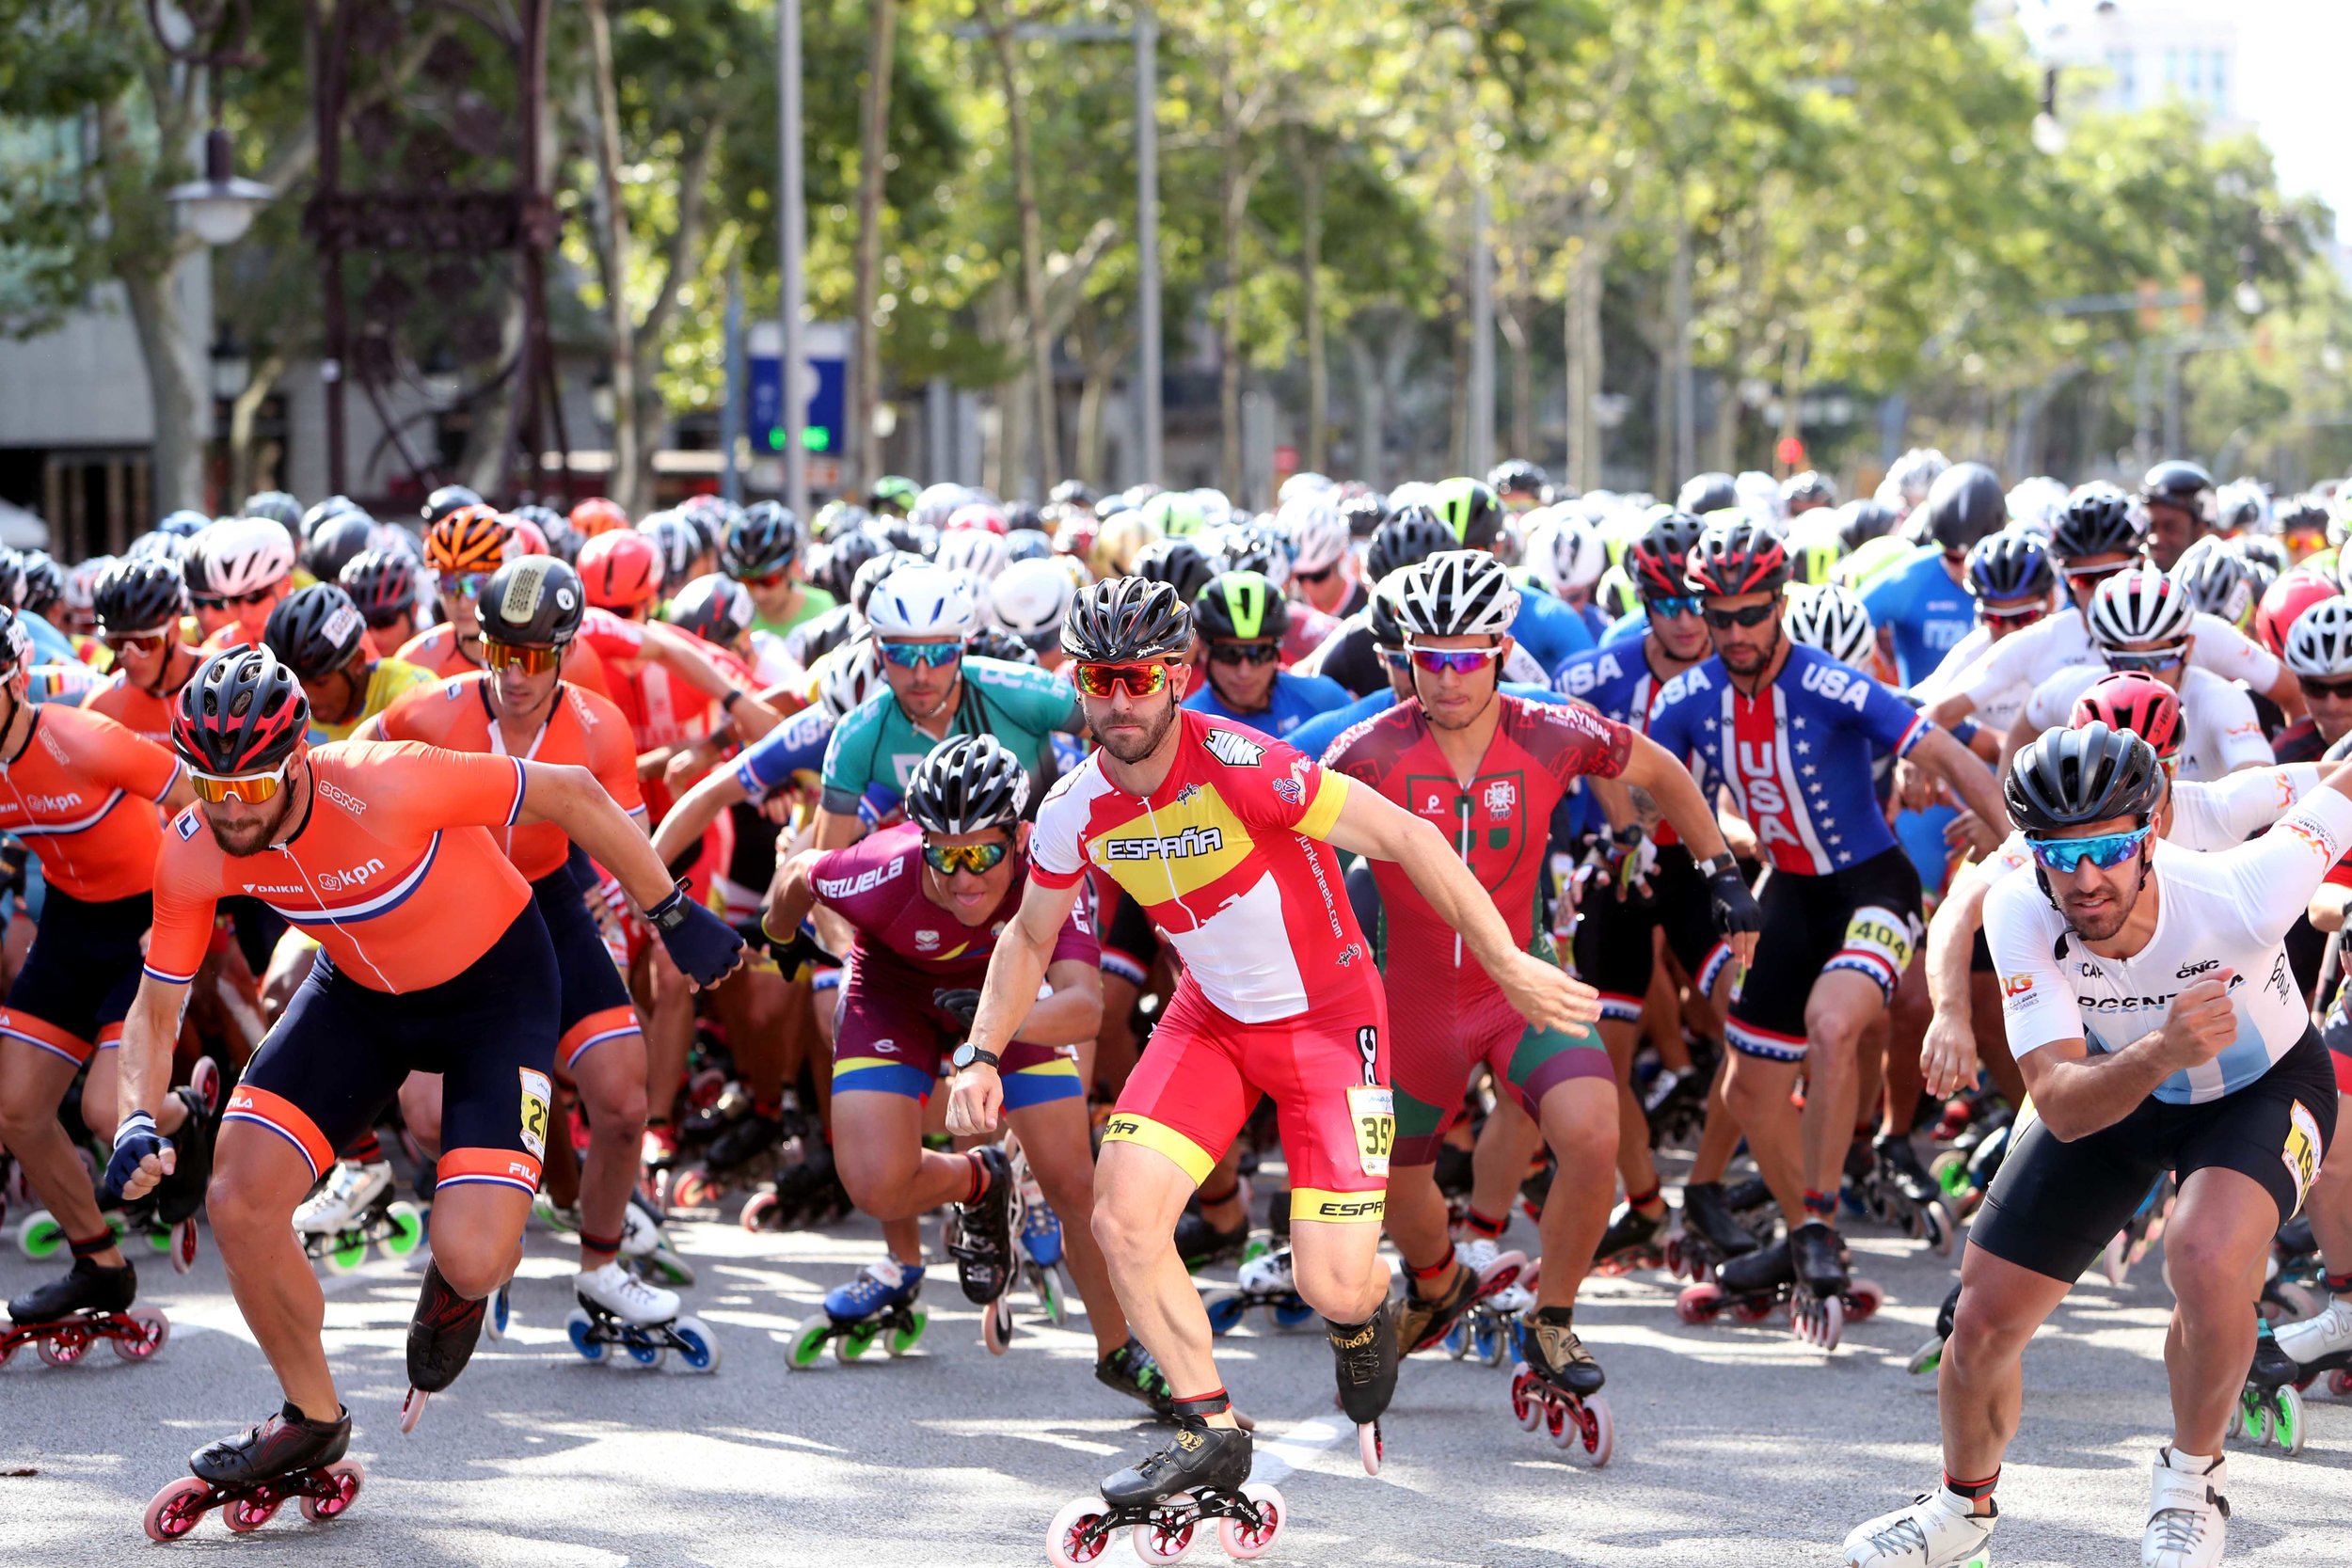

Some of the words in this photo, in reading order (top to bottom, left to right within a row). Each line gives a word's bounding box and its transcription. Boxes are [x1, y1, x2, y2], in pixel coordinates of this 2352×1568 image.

[1801, 662, 1870, 712] USA
[1203, 729, 1265, 766] JUNK
[318, 780, 367, 816] BONT
[1739, 741, 1811, 847] USA
[1106, 826, 1223, 860] ESPAÑA
[338, 858, 385, 887] kpn
[1295, 835, 1343, 940] junkwheels.com
[257, 884, 304, 893] DAIKIN
[1855, 920, 1906, 960] 404
[2176, 959, 2219, 979] CNC
[226, 1097, 254, 1109] FILA
[509, 1162, 536, 1184] FILA
[1159, 1503, 1199, 1512] NEUTRINO
[1236, 1502, 1258, 1521] FLYKE
